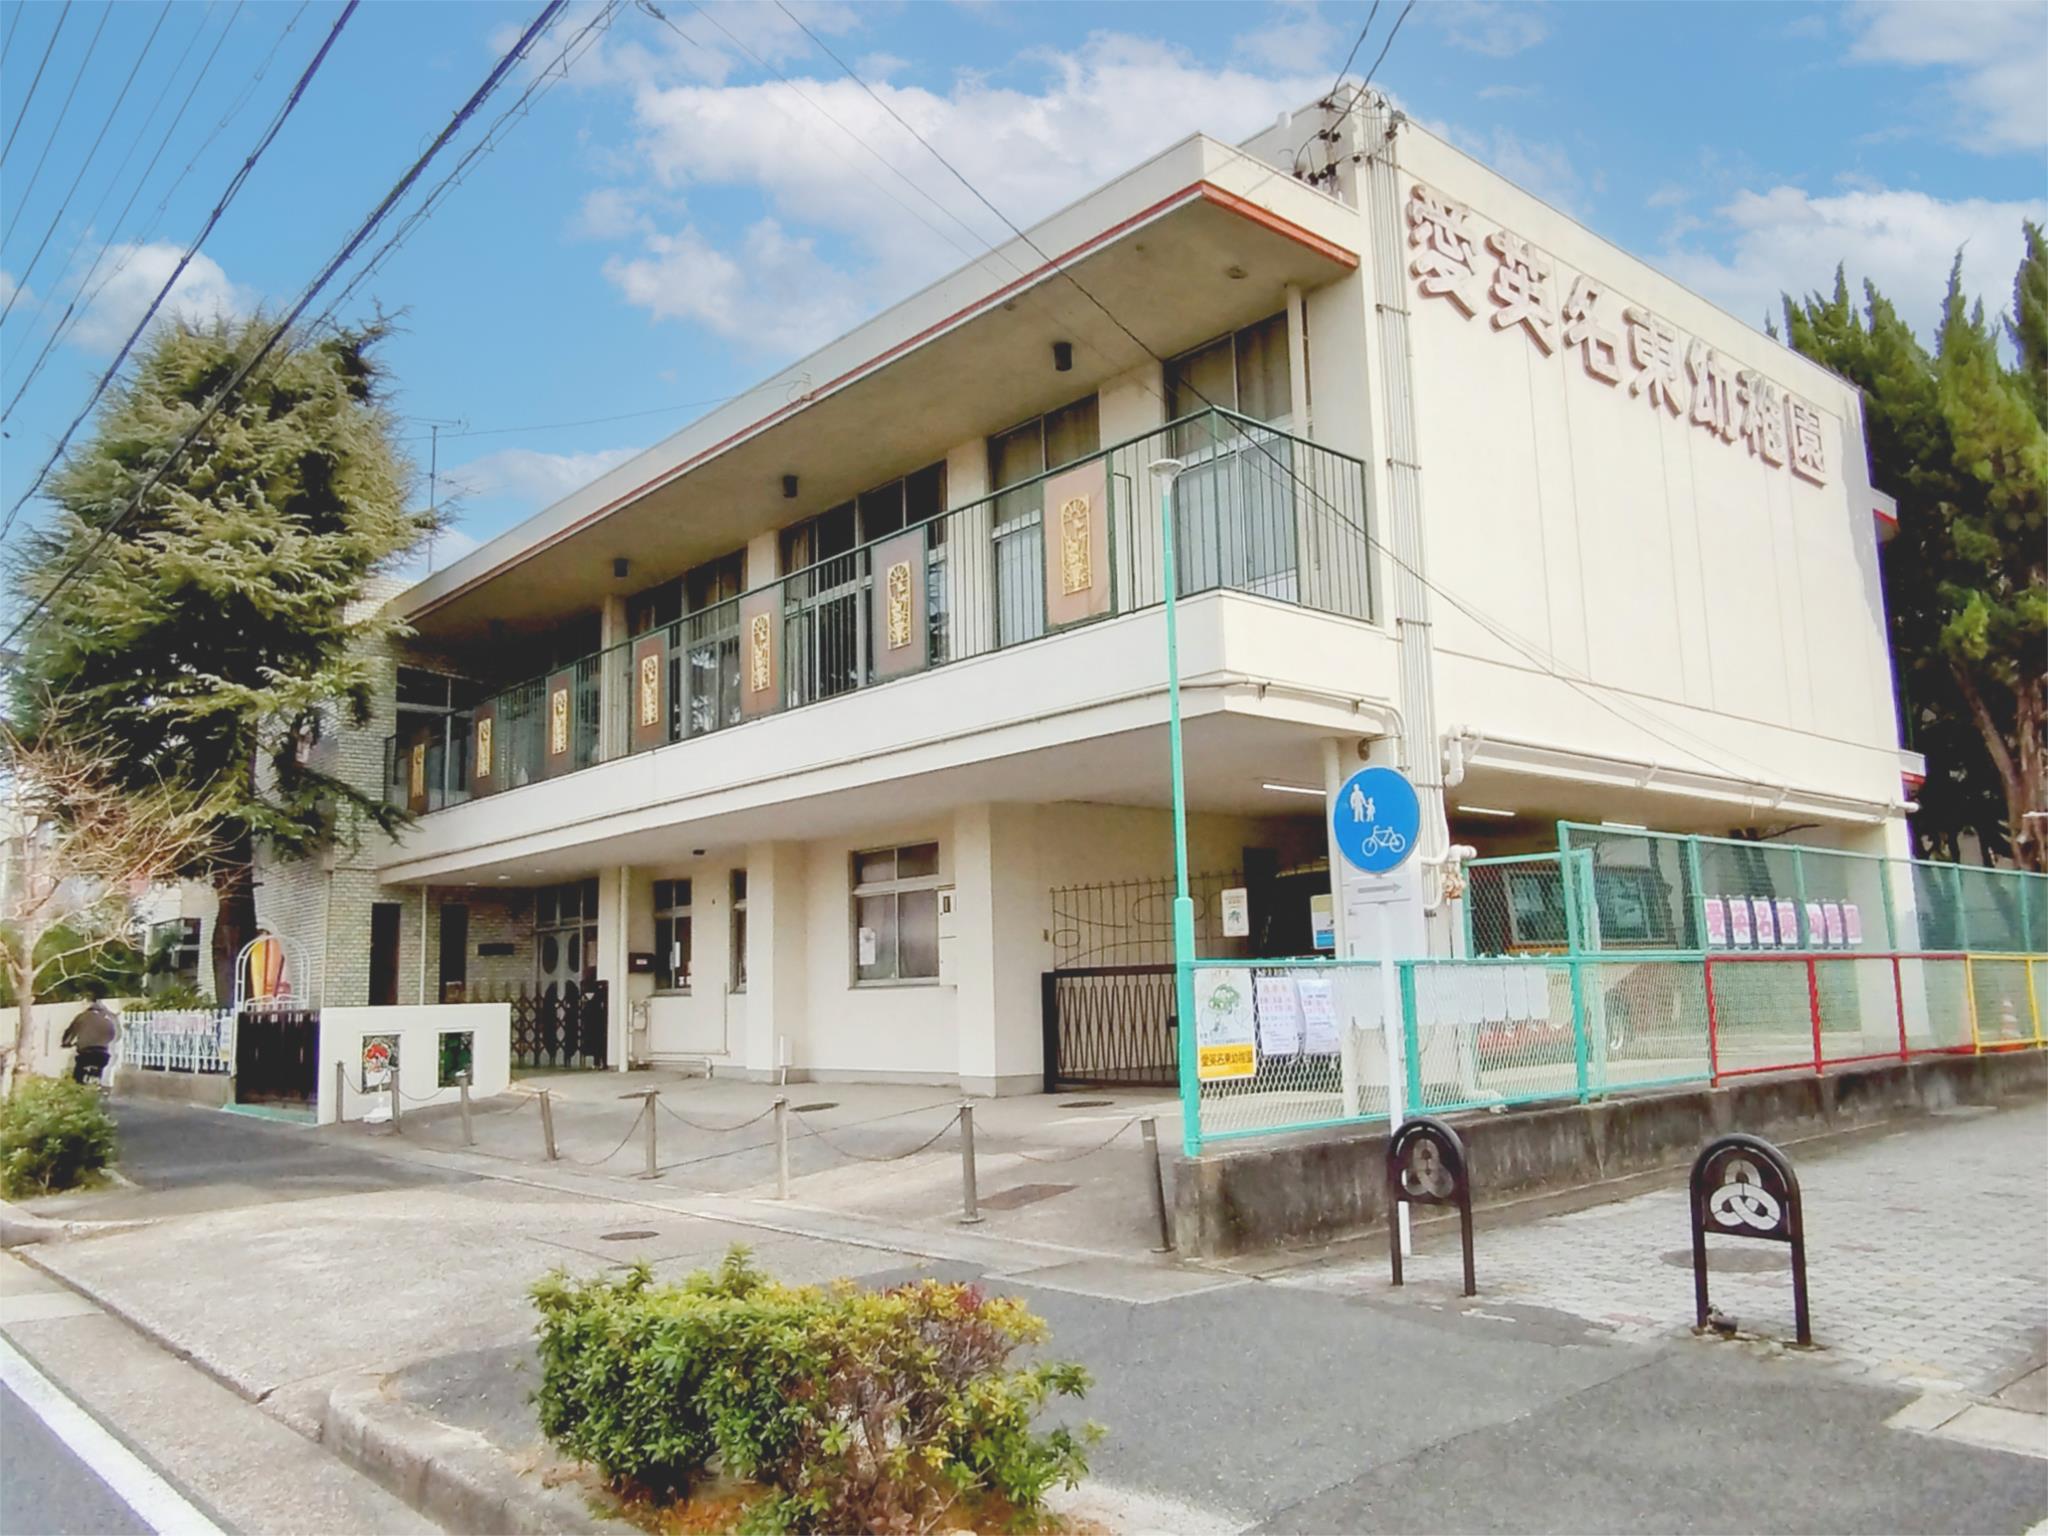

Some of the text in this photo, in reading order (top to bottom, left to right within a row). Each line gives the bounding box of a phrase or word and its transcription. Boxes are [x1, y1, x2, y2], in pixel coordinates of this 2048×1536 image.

[1406, 184, 1828, 488] 愛英名東幼稚園
